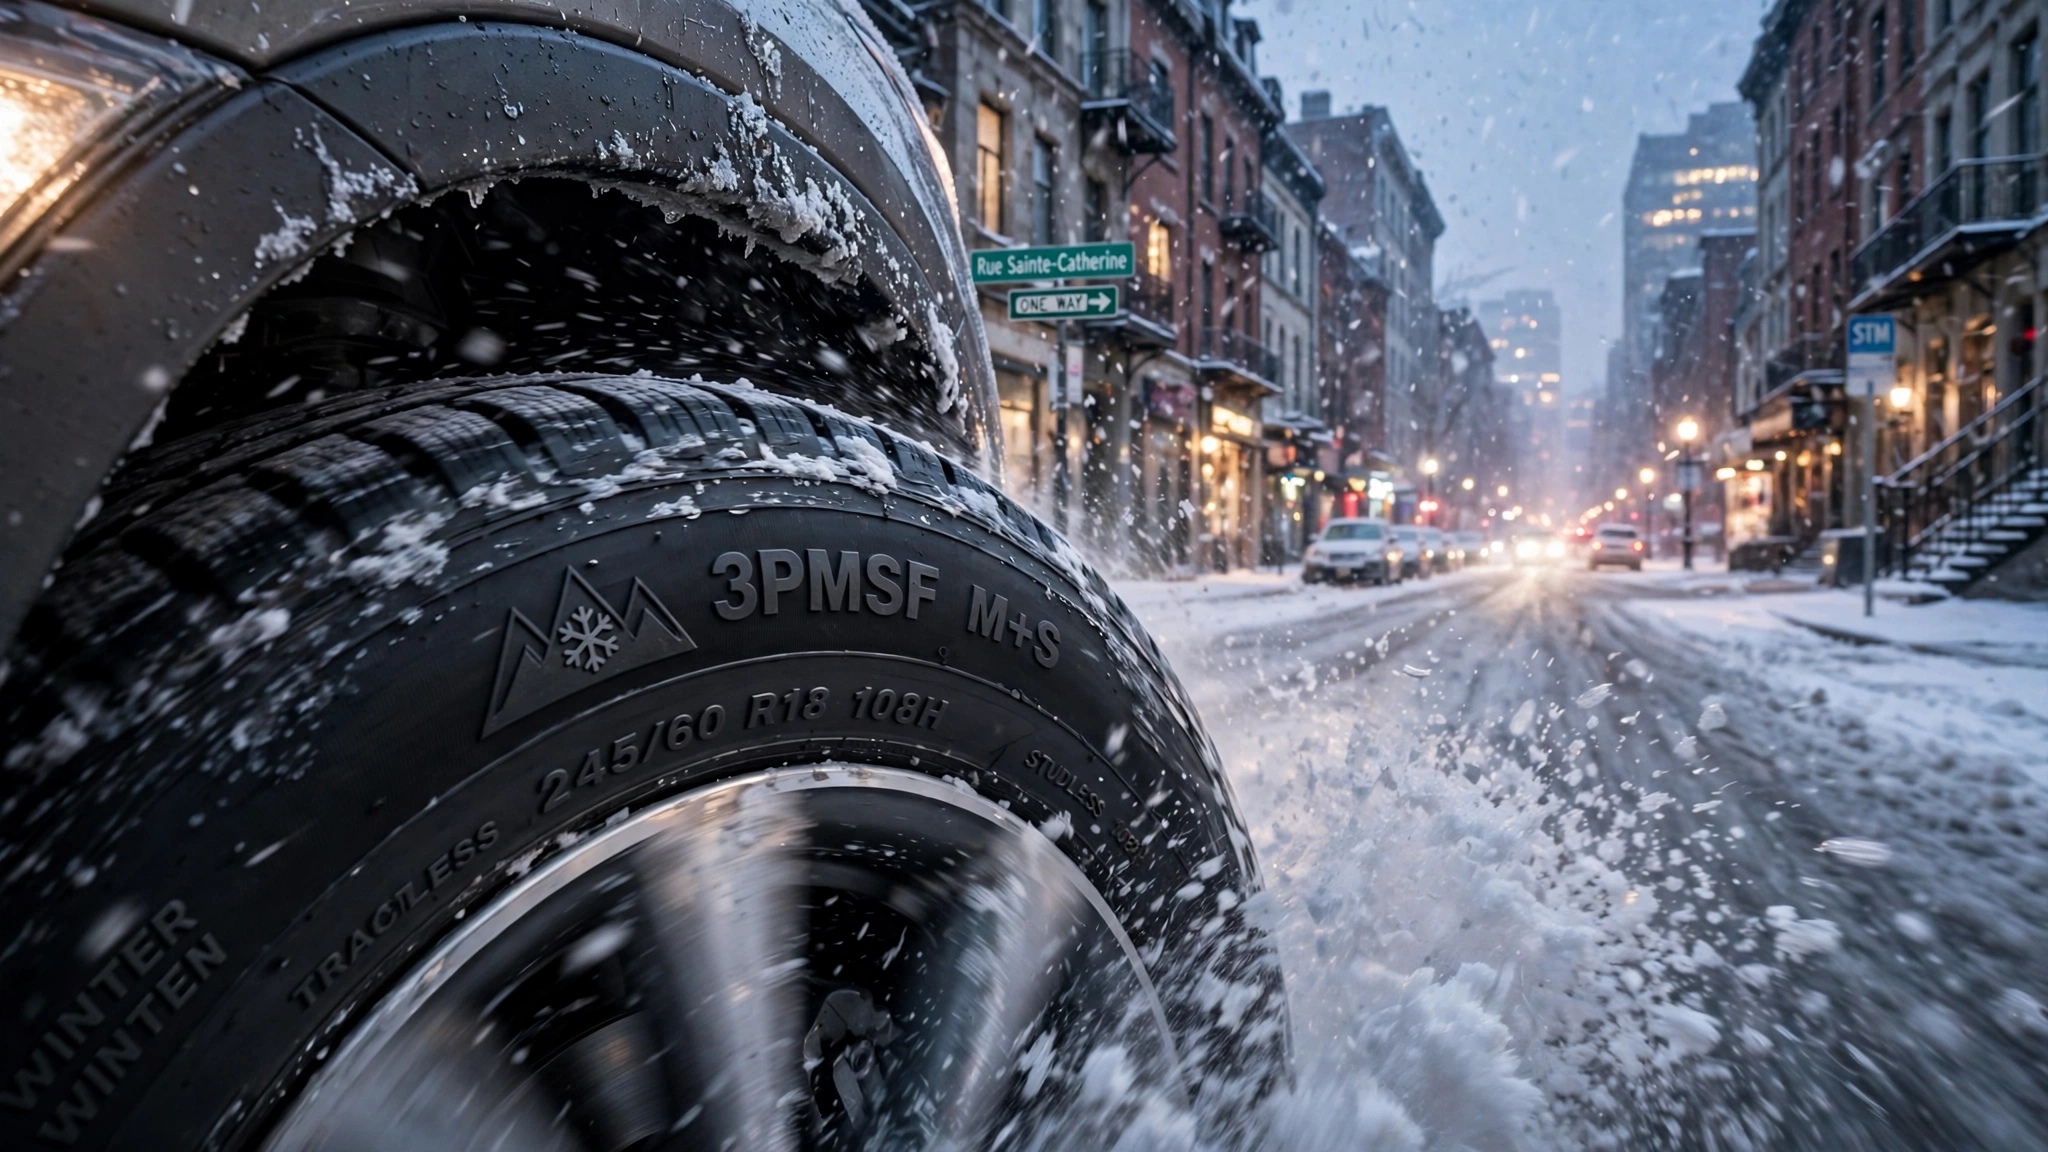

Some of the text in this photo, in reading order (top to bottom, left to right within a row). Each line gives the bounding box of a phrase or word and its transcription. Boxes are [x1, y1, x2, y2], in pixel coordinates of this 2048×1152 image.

[977, 250, 1128, 276] Rue Sainte-Catherine
[1020, 296, 1083, 313] ONE WAY
[1852, 322, 1890, 345] STM
[711, 548, 1062, 669] 3PMSF M+S
[537, 686, 950, 814] 245/60 R18 108H
[0, 899, 199, 1111] WINTER
[36, 932, 229, 1146] WINTEN
